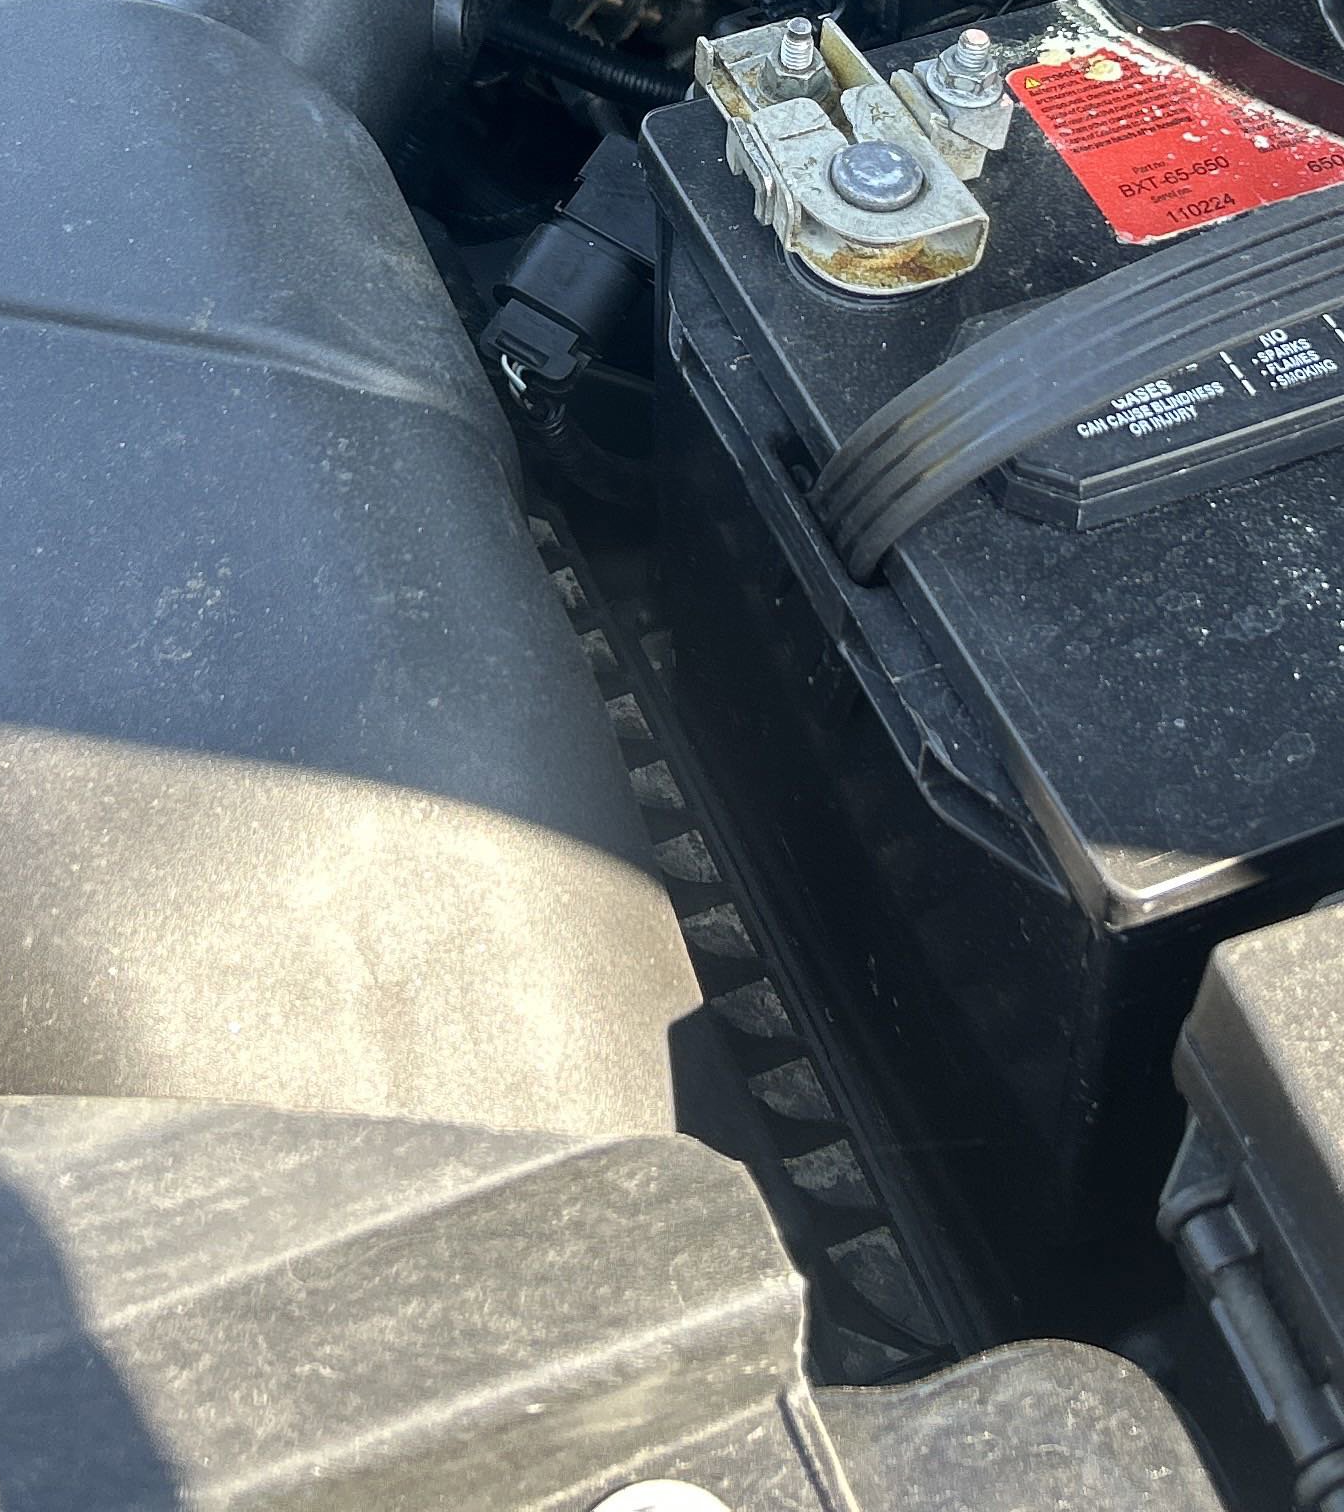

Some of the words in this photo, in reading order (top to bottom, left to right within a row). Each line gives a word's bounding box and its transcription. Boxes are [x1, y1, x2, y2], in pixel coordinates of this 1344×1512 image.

[1117, 154, 1231, 200] BXT-65-650
[1165, 192, 1237, 225] 110224
[1258, 328, 1289, 348] NO
[1076, 417, 1110, 438] CAN
[1105, 405, 1154, 429] CAUSE
[1150, 380, 1225, 416] BLINDNESS
[1110, 379, 1174, 411] GASES
[1128, 419, 1154, 438] OR
[1150, 404, 1199, 432] INJURY
